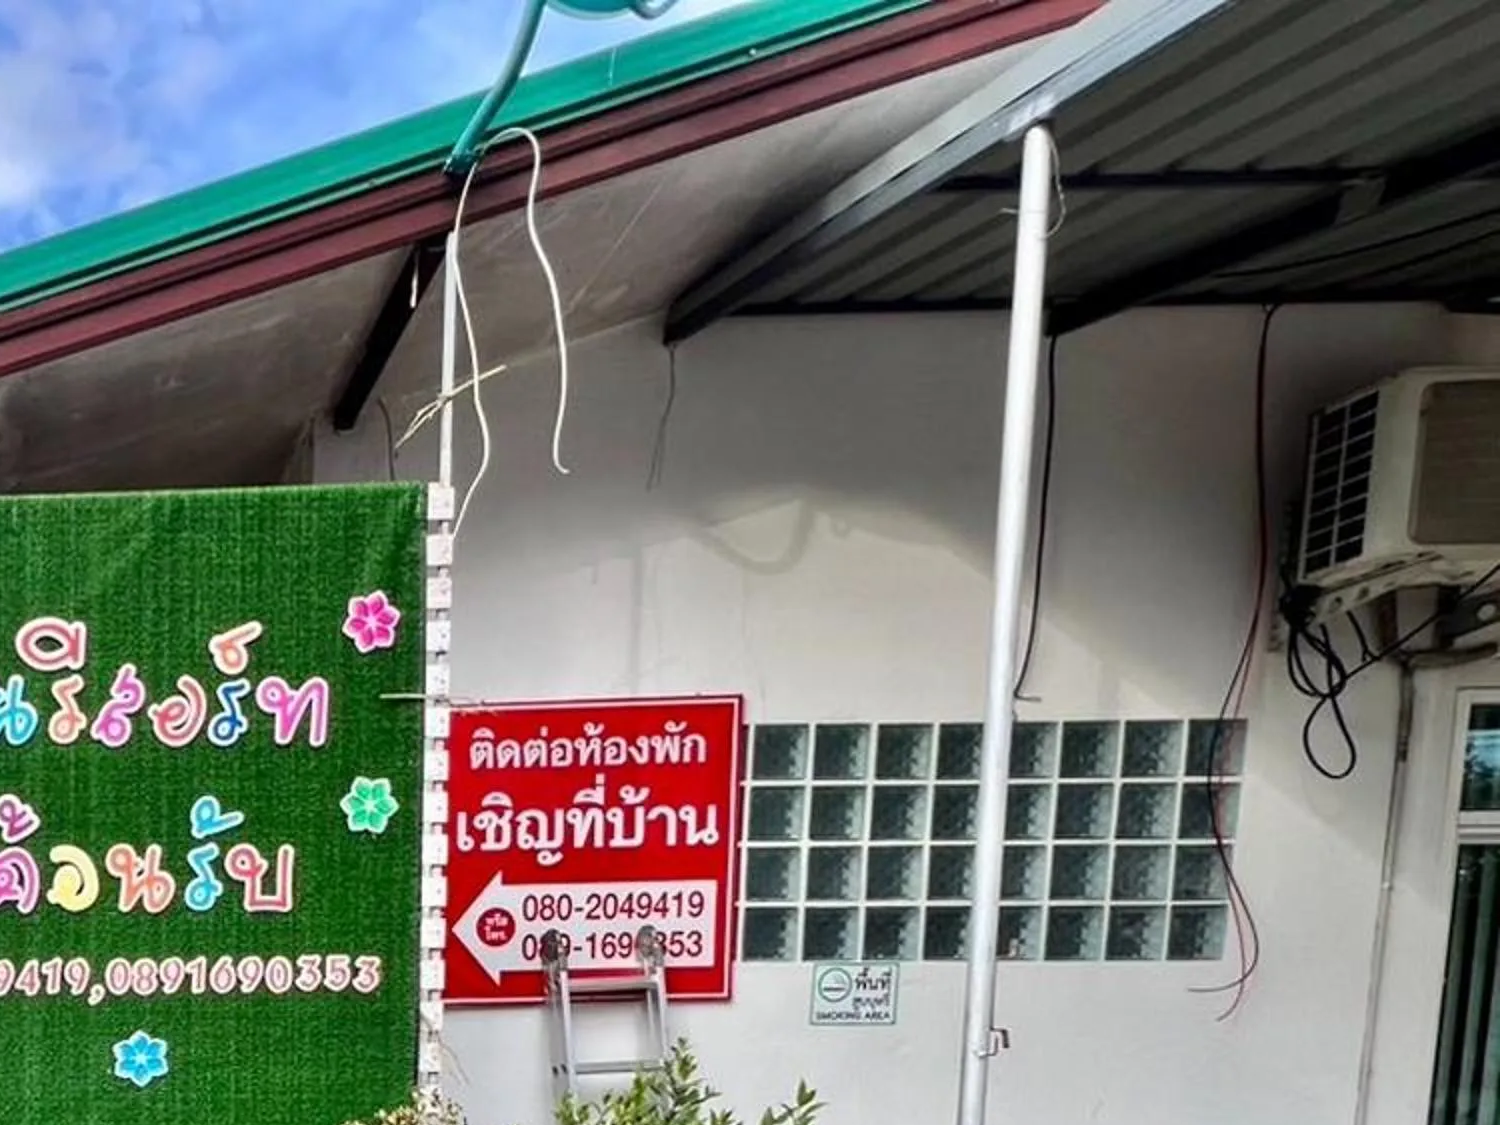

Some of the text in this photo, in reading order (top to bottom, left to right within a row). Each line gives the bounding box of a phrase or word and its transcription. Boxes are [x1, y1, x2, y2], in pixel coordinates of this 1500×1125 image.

[469, 720, 707, 770] ติดต่อห้องพัก
[456, 774, 719, 865] เชิญที่บ้าน
[522, 891, 705, 922] 080-2049419
